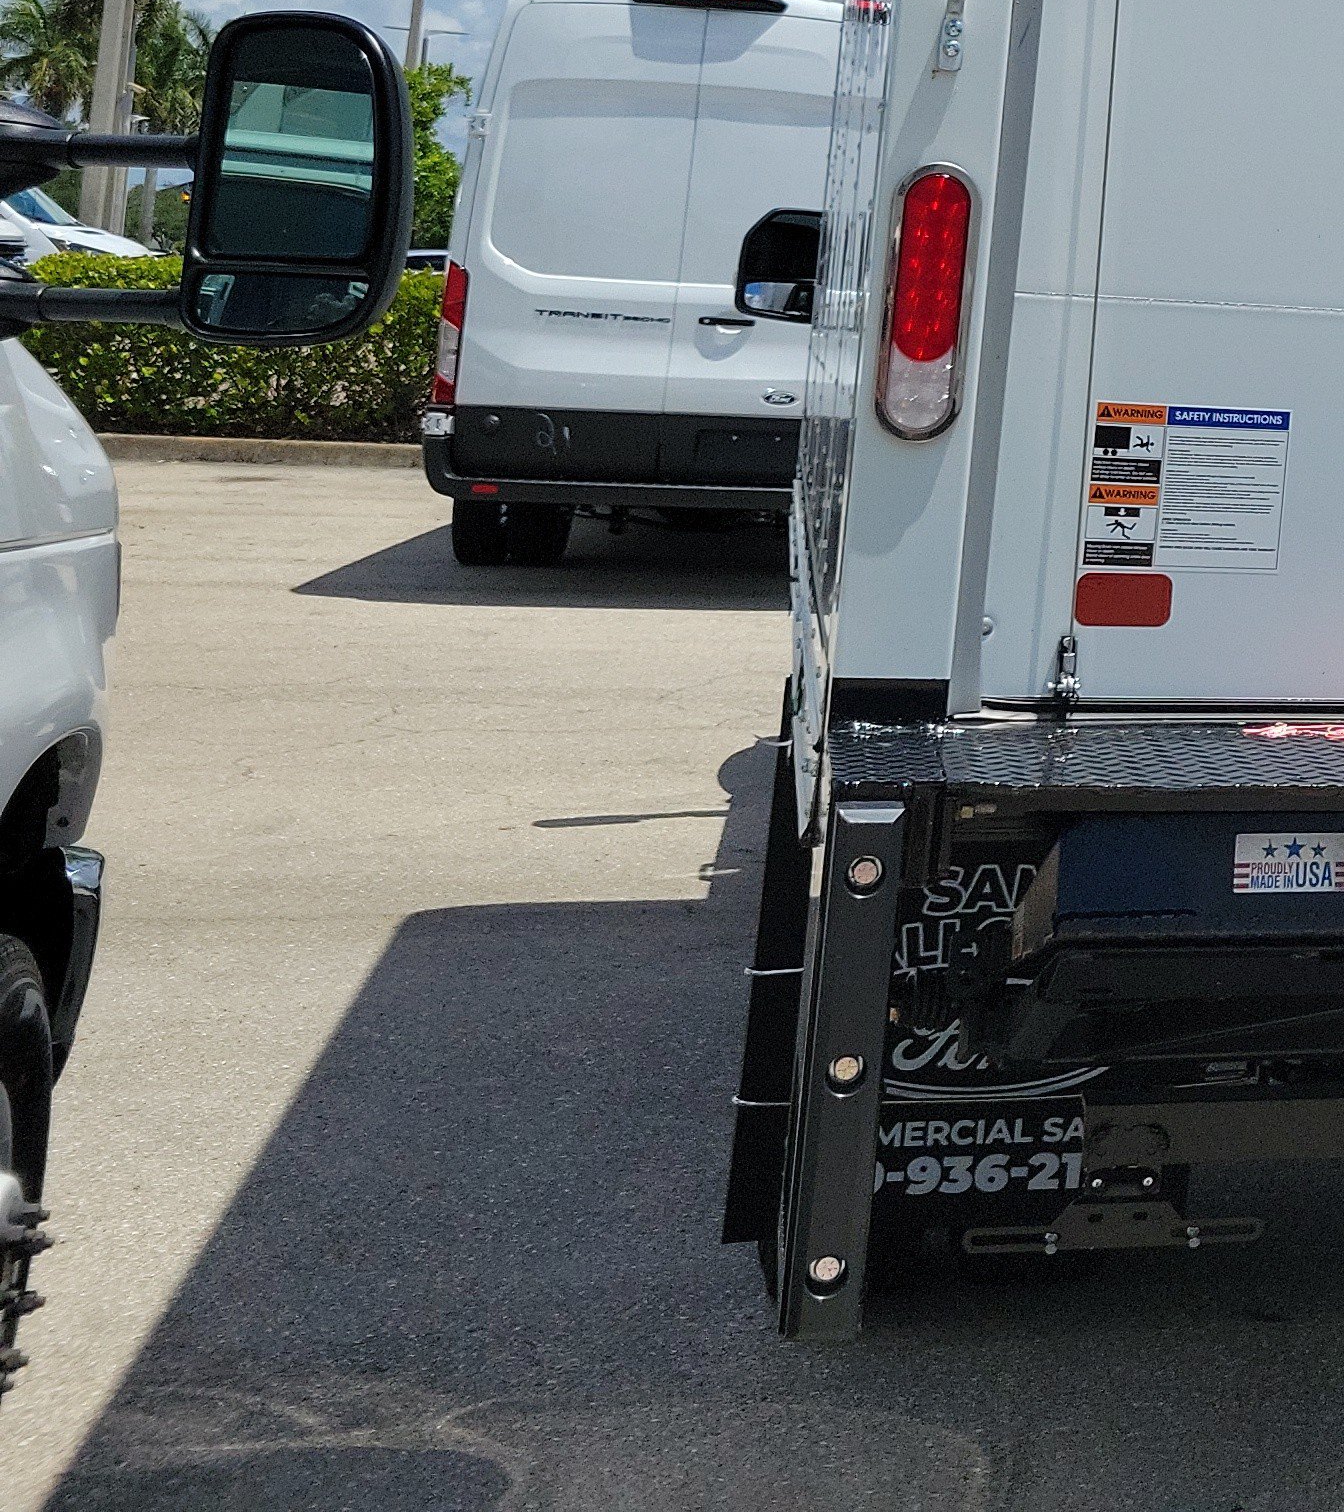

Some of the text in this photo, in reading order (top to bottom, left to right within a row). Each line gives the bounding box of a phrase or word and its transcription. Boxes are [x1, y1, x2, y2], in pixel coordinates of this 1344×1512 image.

[535, 308, 623, 320] TRANSIT
[1112, 406, 1164, 420] WARNING
[1175, 410, 1283, 426] SAFETY INSTRUCTIONS
[1104, 488, 1156, 501] WARNING
[1251, 861, 1333, 888] PROUDLY USA
[1250, 875, 1294, 889] MADE IN
